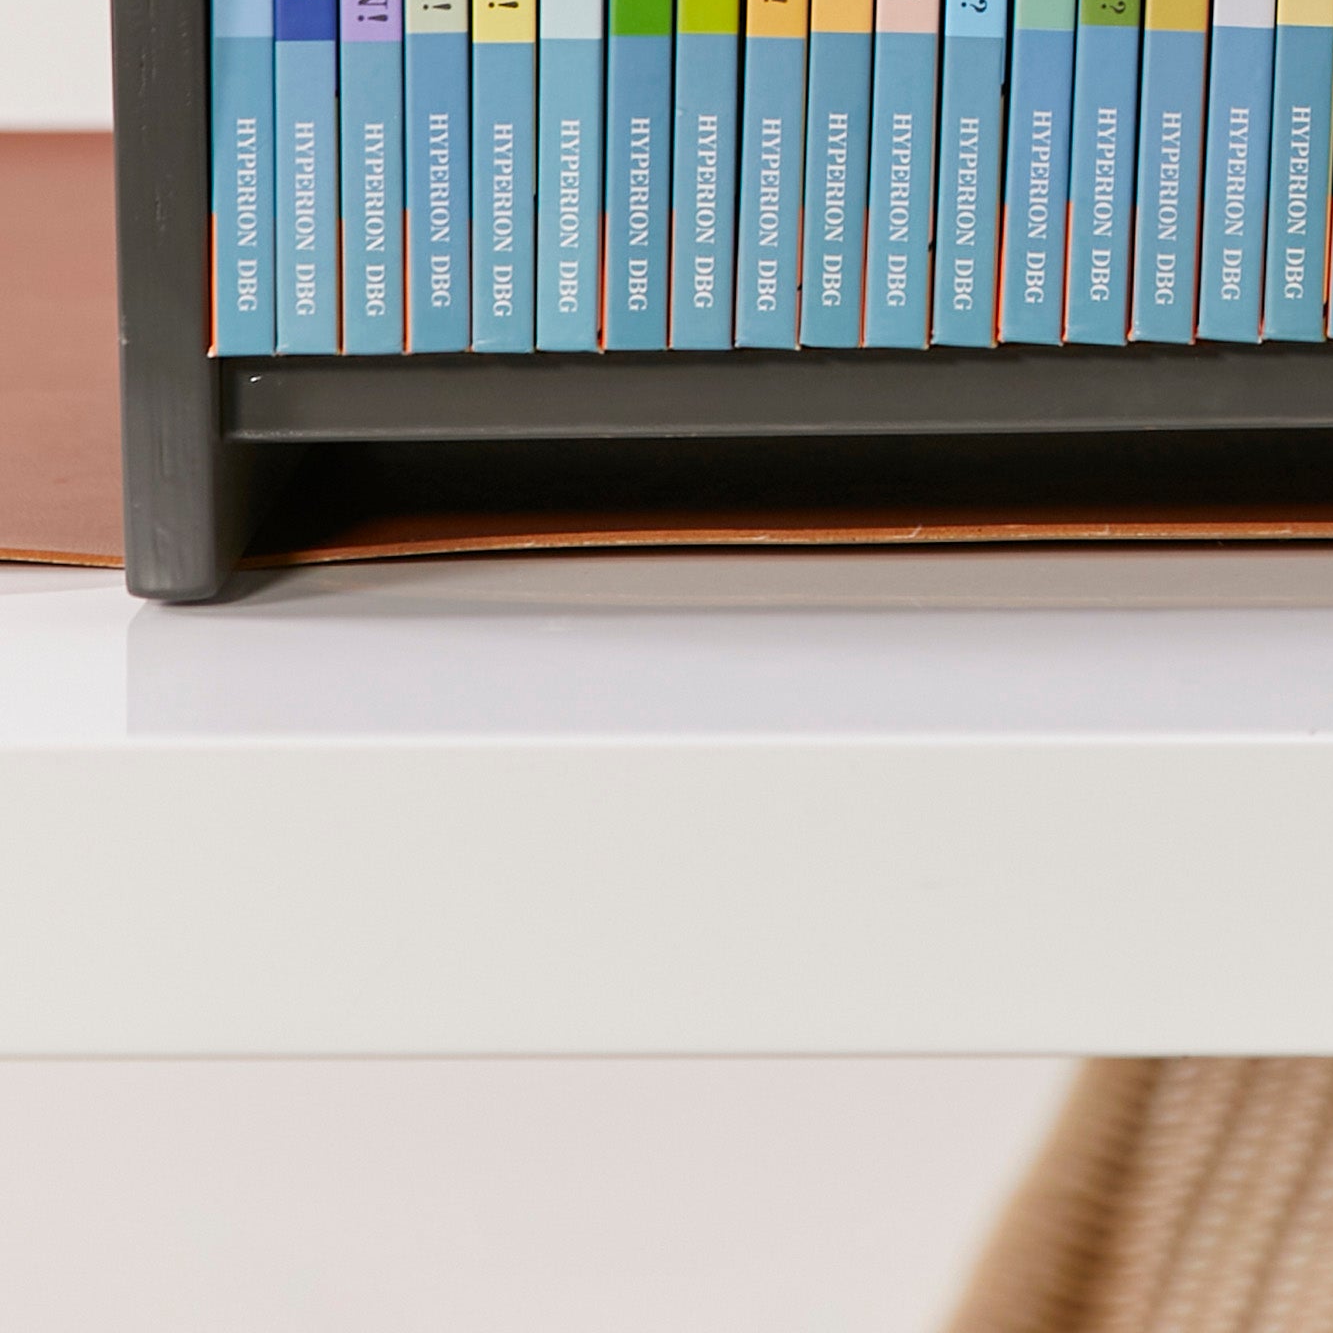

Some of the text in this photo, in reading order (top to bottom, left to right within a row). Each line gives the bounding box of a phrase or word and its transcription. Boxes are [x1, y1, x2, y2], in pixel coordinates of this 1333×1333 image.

[294, 120, 317, 317] HYPERION DBG
[492, 123, 514, 317] HYPERION DBG
[821, 113, 849, 307] HYPERION DBG
[1024, 110, 1053, 304] HYPERION DBG
[1220, 106, 1250, 301] HYPERION DBG
